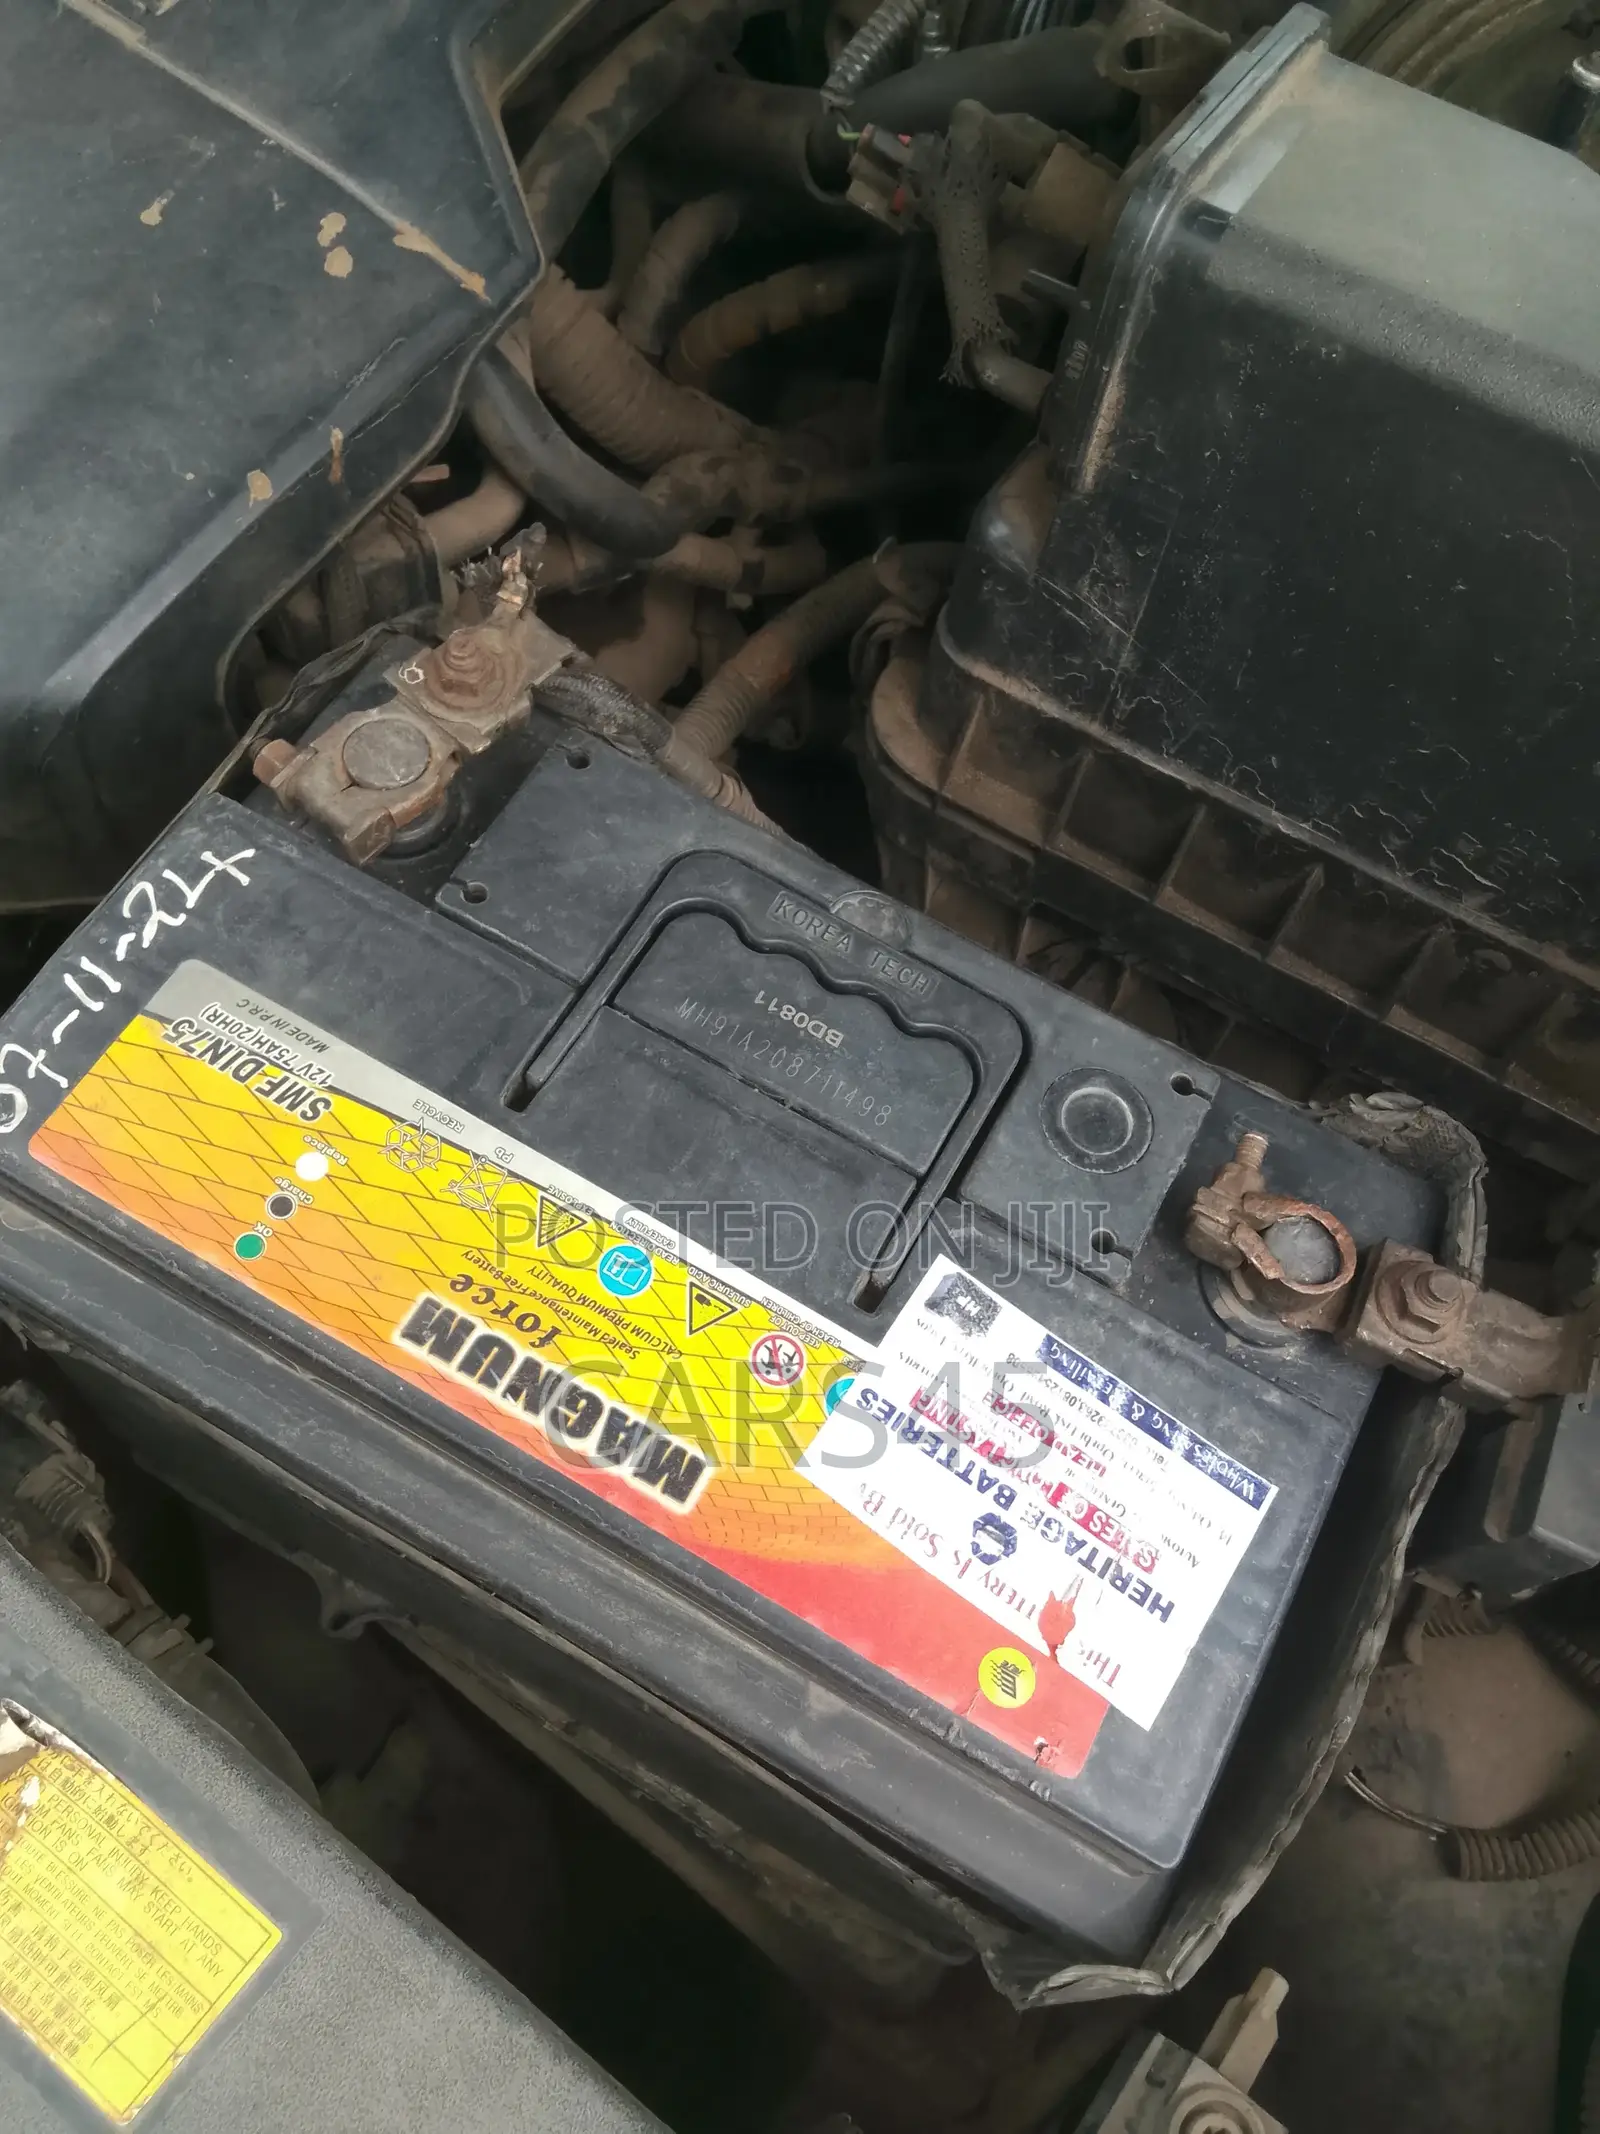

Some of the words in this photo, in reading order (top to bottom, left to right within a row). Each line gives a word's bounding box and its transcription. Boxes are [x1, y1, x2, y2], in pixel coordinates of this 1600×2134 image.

[773, 896, 857, 952] KOREA
[867, 947, 932, 994] TECH
[199, 999, 301, 1068] 75AH(20HR)
[270, 1015, 290, 1033] IN
[753, 986, 845, 1051] BD0811
[161, 1011, 267, 1088] DIN75
[286, 1024, 330, 1055] MADE
[296, 1057, 334, 1088] 12V
[254, 1064, 334, 1127] SMF
[414, 1097, 466, 1134] RECYCLE
[300, 1132, 349, 1166] Replace
[492, 1145, 514, 1164] Pb
[271, 1174, 315, 1205] Charge
[545, 1183, 595, 1217] EXPLOSIVE
[252, 1219, 275, 1238] OK
[608, 1219, 661, 1255] DIRECTION
[624, 1214, 677, 1250] CAREFULLY
[460, 1246, 505, 1280] Battery
[658, 1248, 680, 1266] READ
[499, 1271, 530, 1295] Free
[526, 1261, 579, 1299] QUALITY
[685, 1265, 713, 1286] ACID
[709, 1278, 752, 1308] SULFURIC
[759, 1296, 801, 1324] CHILDREN
[442, 1268, 563, 1355] force
[526, 1287, 602, 1338] Maintenance
[575, 1291, 632, 1330] PREMIUM
[768, 1313, 783, 1326] OF
[800, 1319, 813, 1332] OF
[629, 1323, 684, 1361] CALCIUM
[780, 1320, 800, 1336] OUT
[798, 1330, 822, 1349] KEEP
[811, 1326, 841, 1348] REACH
[599, 1330, 641, 1361] Sealed
[396, 1291, 710, 1506] MAGNUM
[852, 1385, 1019, 1512] BATTERIES
[1017, 1500, 1178, 1624] HERITAGE
[50, 1836, 68, 1854] IS
[66, 1849, 89, 1872] ON
[47, 1791, 108, 1849] PERSONAL
[147, 1885, 182, 1919] KEEP
[179, 1915, 223, 1957] HANDS
[114, 1876, 143, 1904] MAY
[140, 1900, 181, 1938] START
[178, 1935, 198, 1955] AT
[195, 1952, 224, 1980] ANY
